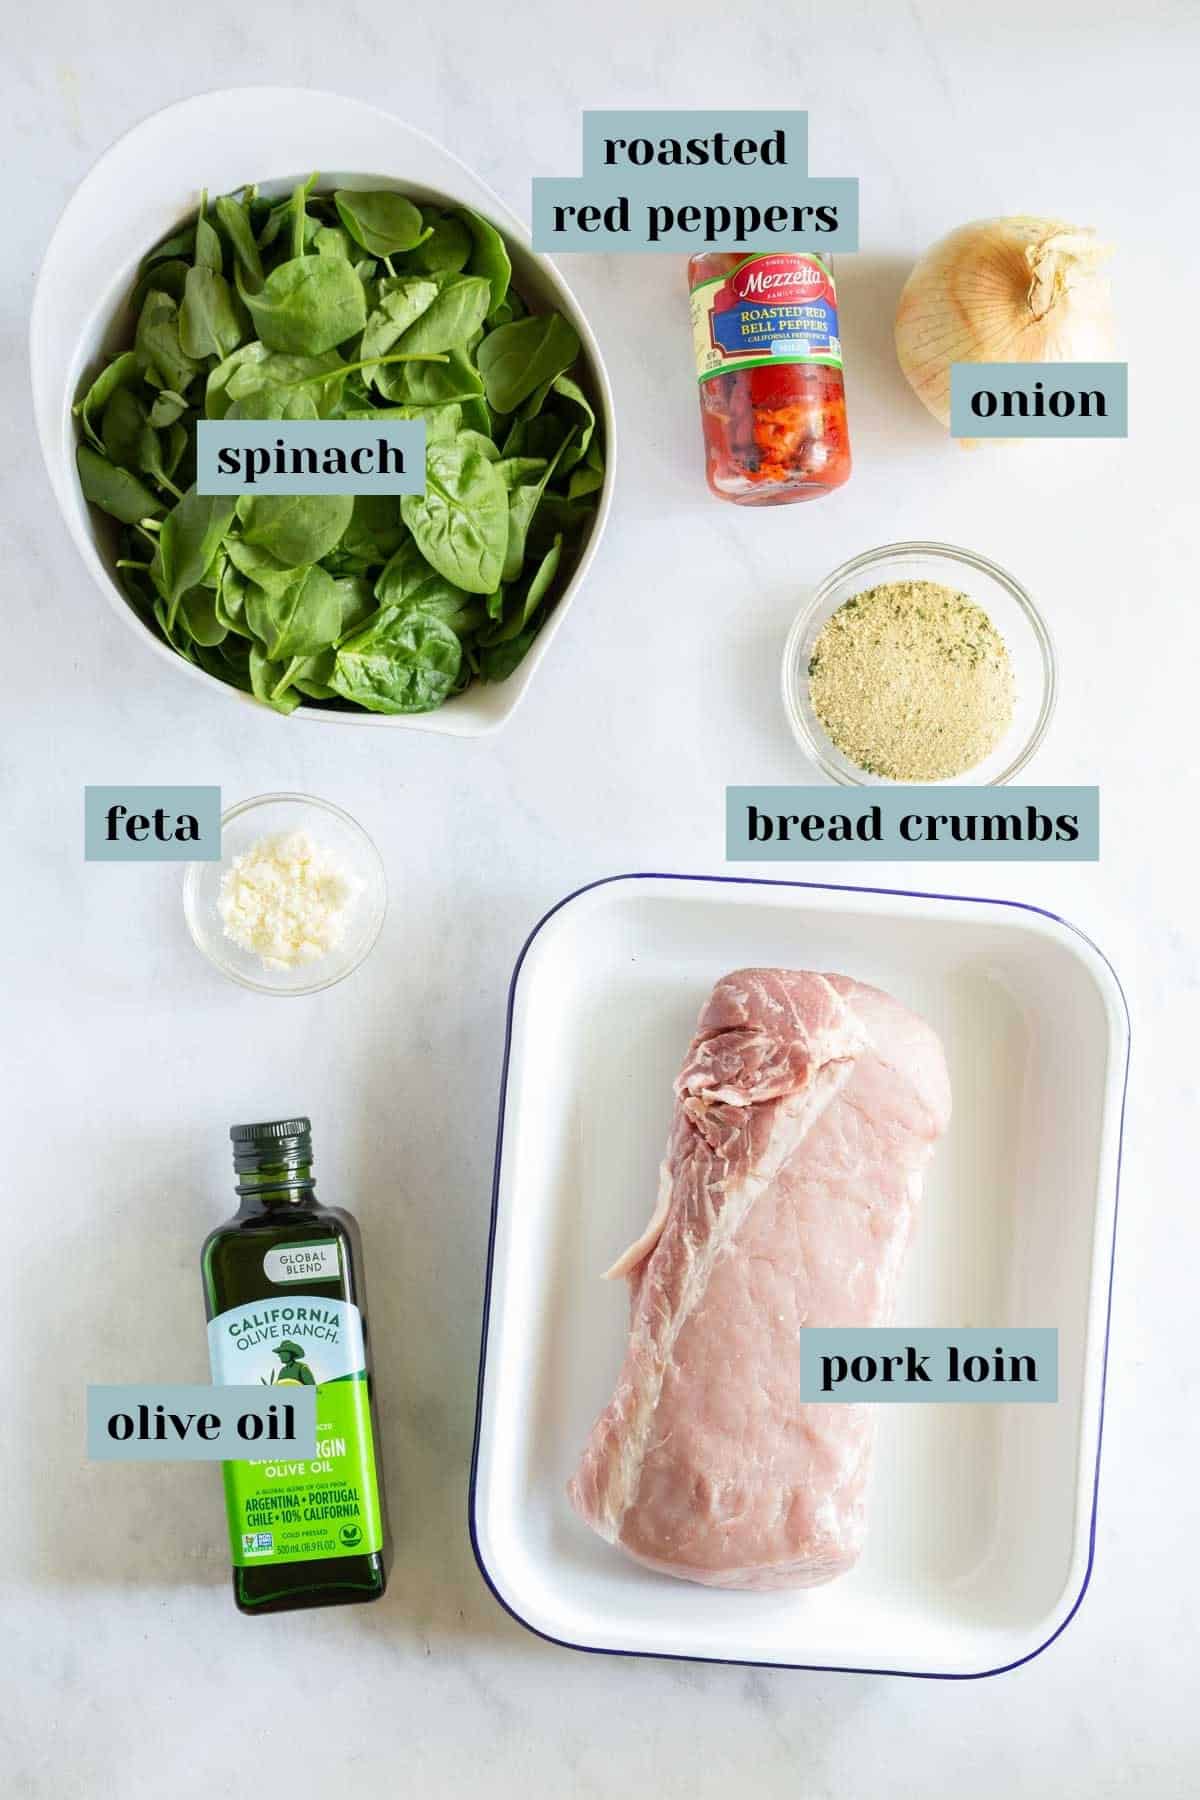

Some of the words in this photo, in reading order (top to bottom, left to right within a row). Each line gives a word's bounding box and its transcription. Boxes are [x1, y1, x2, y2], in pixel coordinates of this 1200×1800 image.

[739, 266, 823, 297] Mezzetta
[741, 306, 802, 322] ROASTED
[806, 307, 826, 319] RED
[741, 321, 776, 336] BELL
[779, 319, 828, 333] PEPPERS
[280, 1251, 327, 1265] GLOBAL
[286, 1262, 322, 1275] BLEND
[228, 1307, 341, 1337] CALIFORNIA
[236, 1325, 279, 1351] OLIVE
[265, 1463, 305, 1478] OLIVE
[311, 1460, 333, 1473] OIL
[245, 1494, 300, 1512] ARGENTINA
[309, 1489, 360, 1506] PORTUGAL
[247, 1512, 274, 1528] CHILE
[281, 1510, 302, 1524] 10%
[304, 1504, 360, 1521] CALIFORNIA
